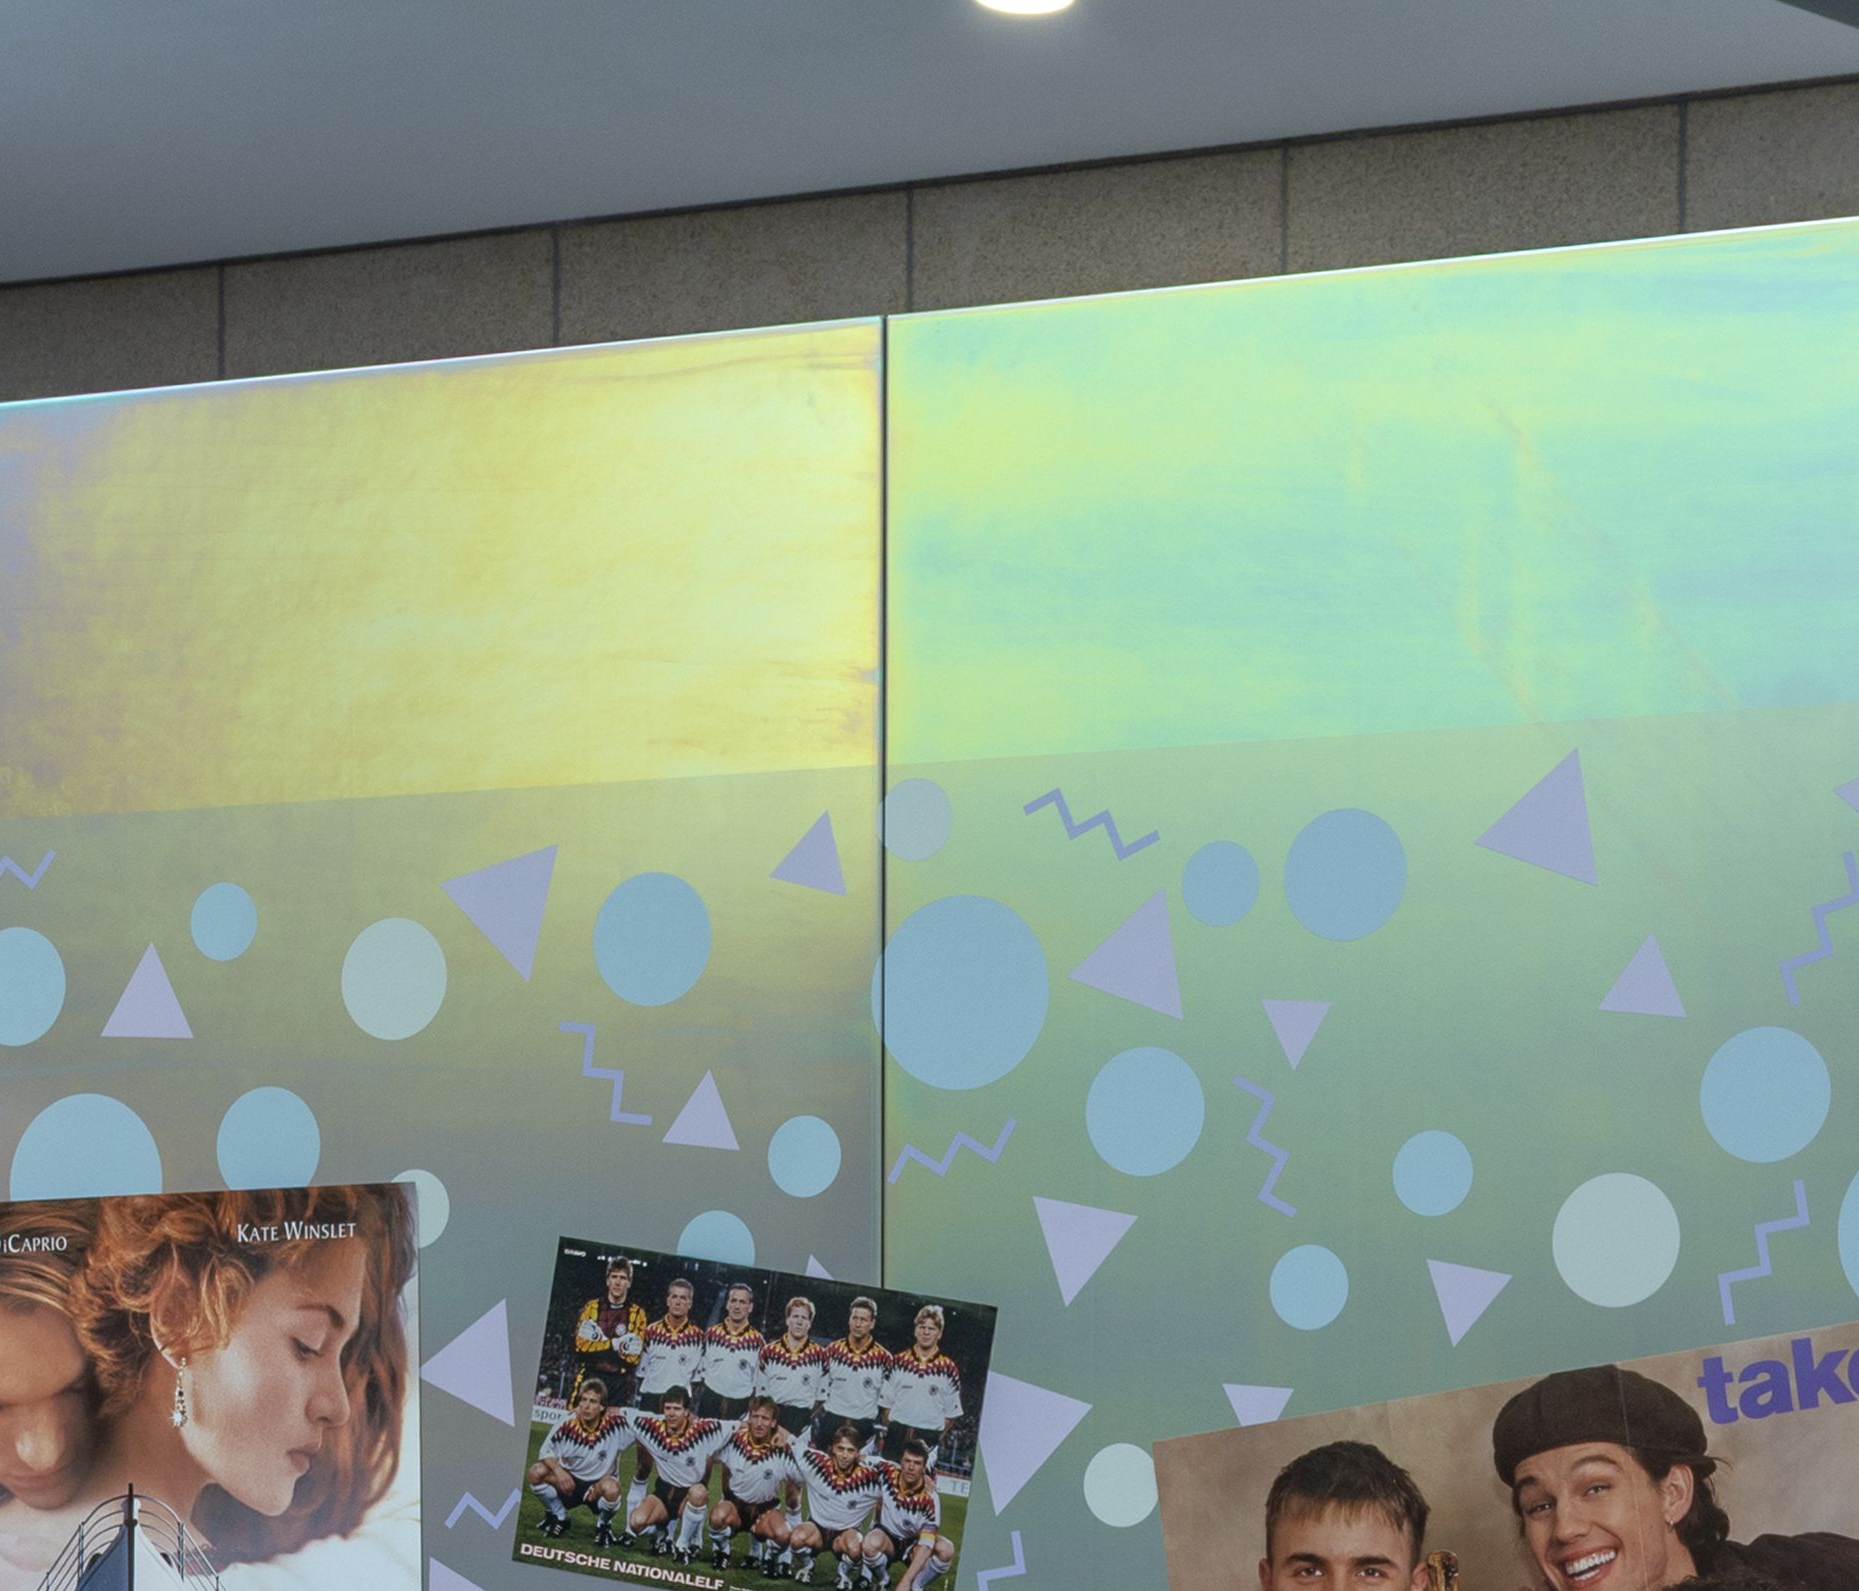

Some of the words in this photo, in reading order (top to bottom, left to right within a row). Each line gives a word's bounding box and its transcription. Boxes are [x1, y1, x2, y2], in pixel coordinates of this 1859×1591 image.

[237, 1223, 278, 1242] KATE
[284, 1221, 356, 1240] WINSLET
[519, 1542, 612, 1569] DEUTSCHE
